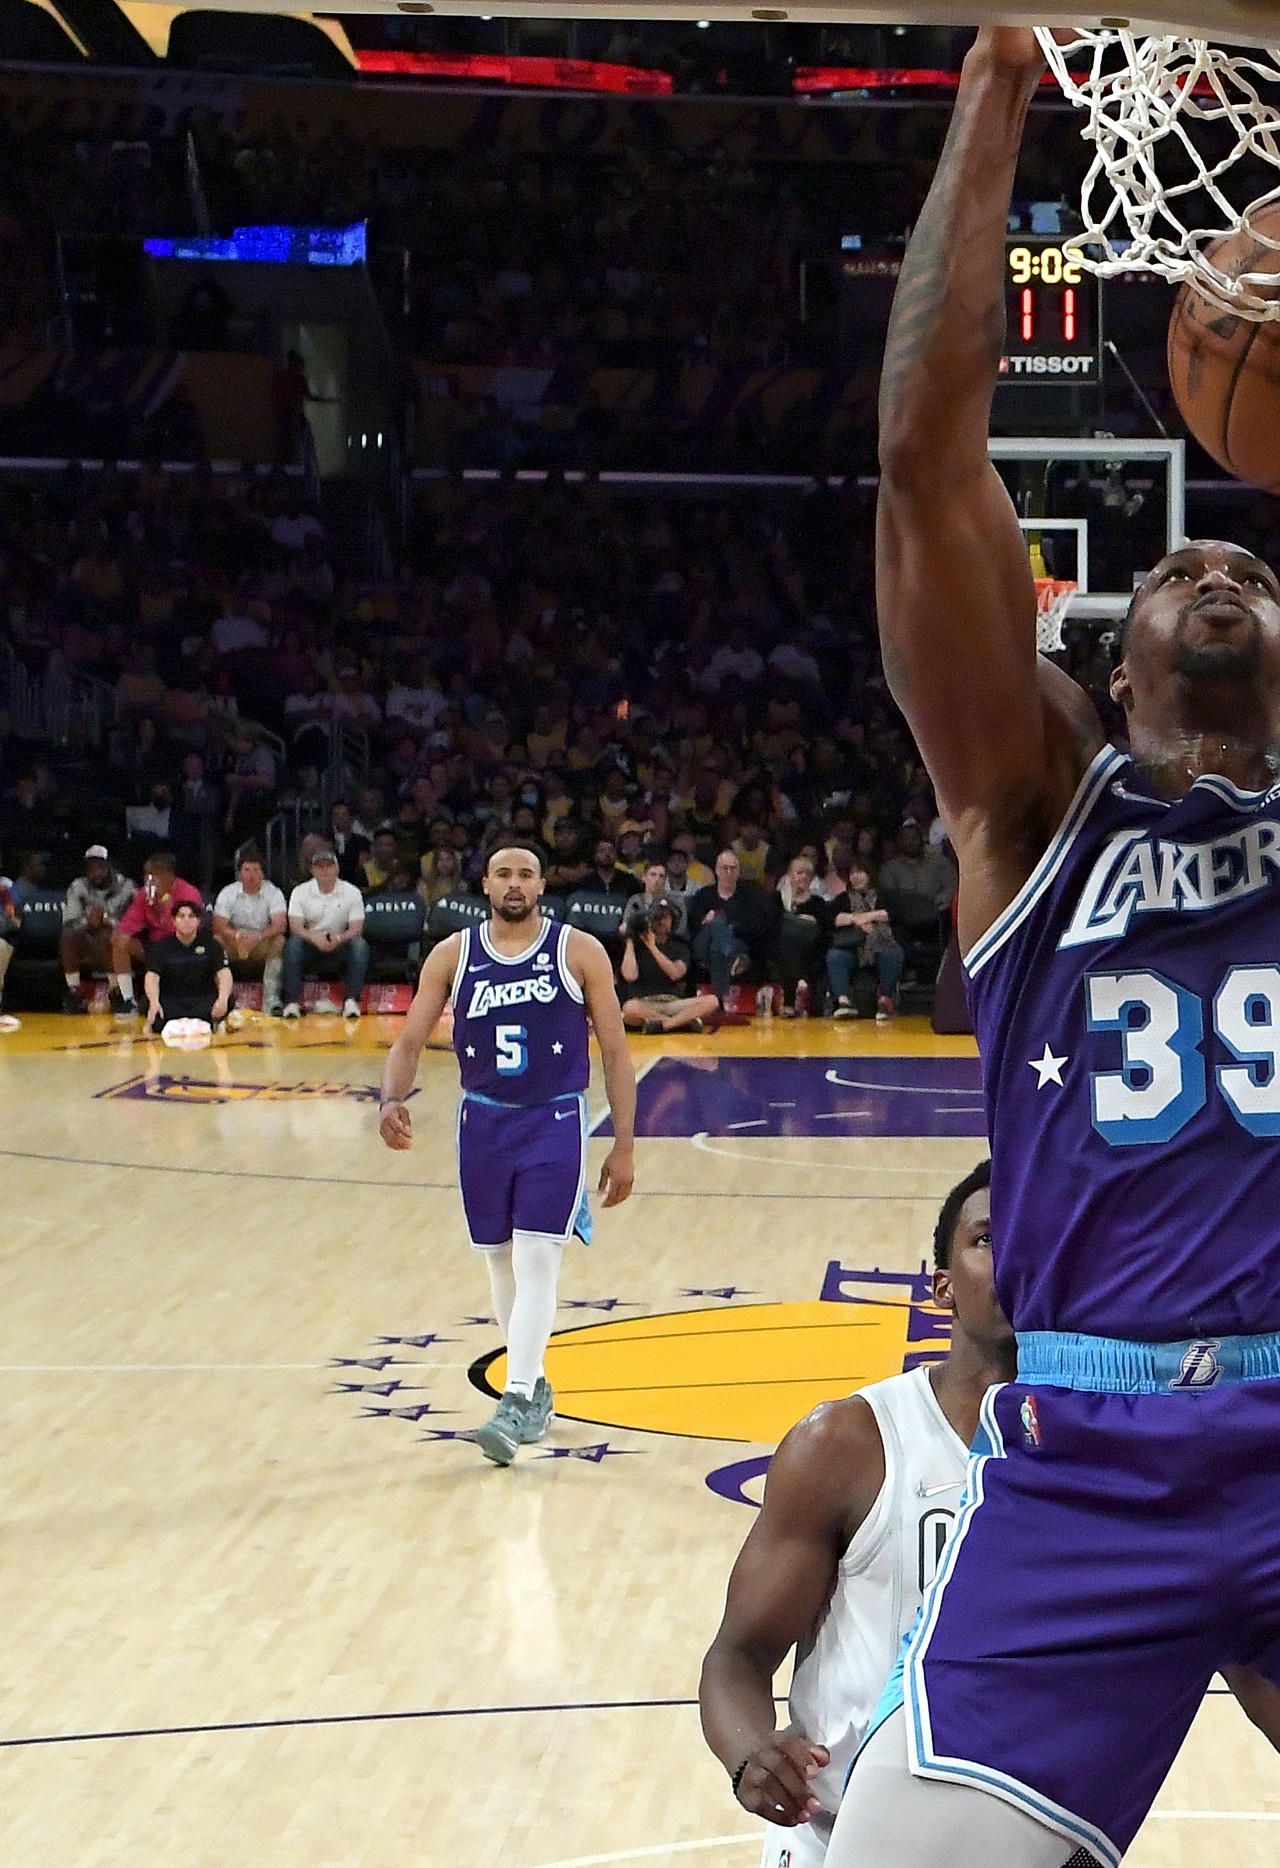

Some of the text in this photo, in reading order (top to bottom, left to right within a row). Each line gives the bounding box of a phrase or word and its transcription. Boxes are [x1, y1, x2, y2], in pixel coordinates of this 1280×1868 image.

[1009, 247, 1084, 284] 9:02
[1021, 288, 1075, 341] 11
[1010, 356, 1094, 374] TISSOT
[375, 901, 416, 912] DELTA
[449, 901, 488, 920] DELTA
[583, 903, 623, 914] DELTA
[466, 974, 559, 1020] LAKERS
[494, 1024, 529, 1077] 5
